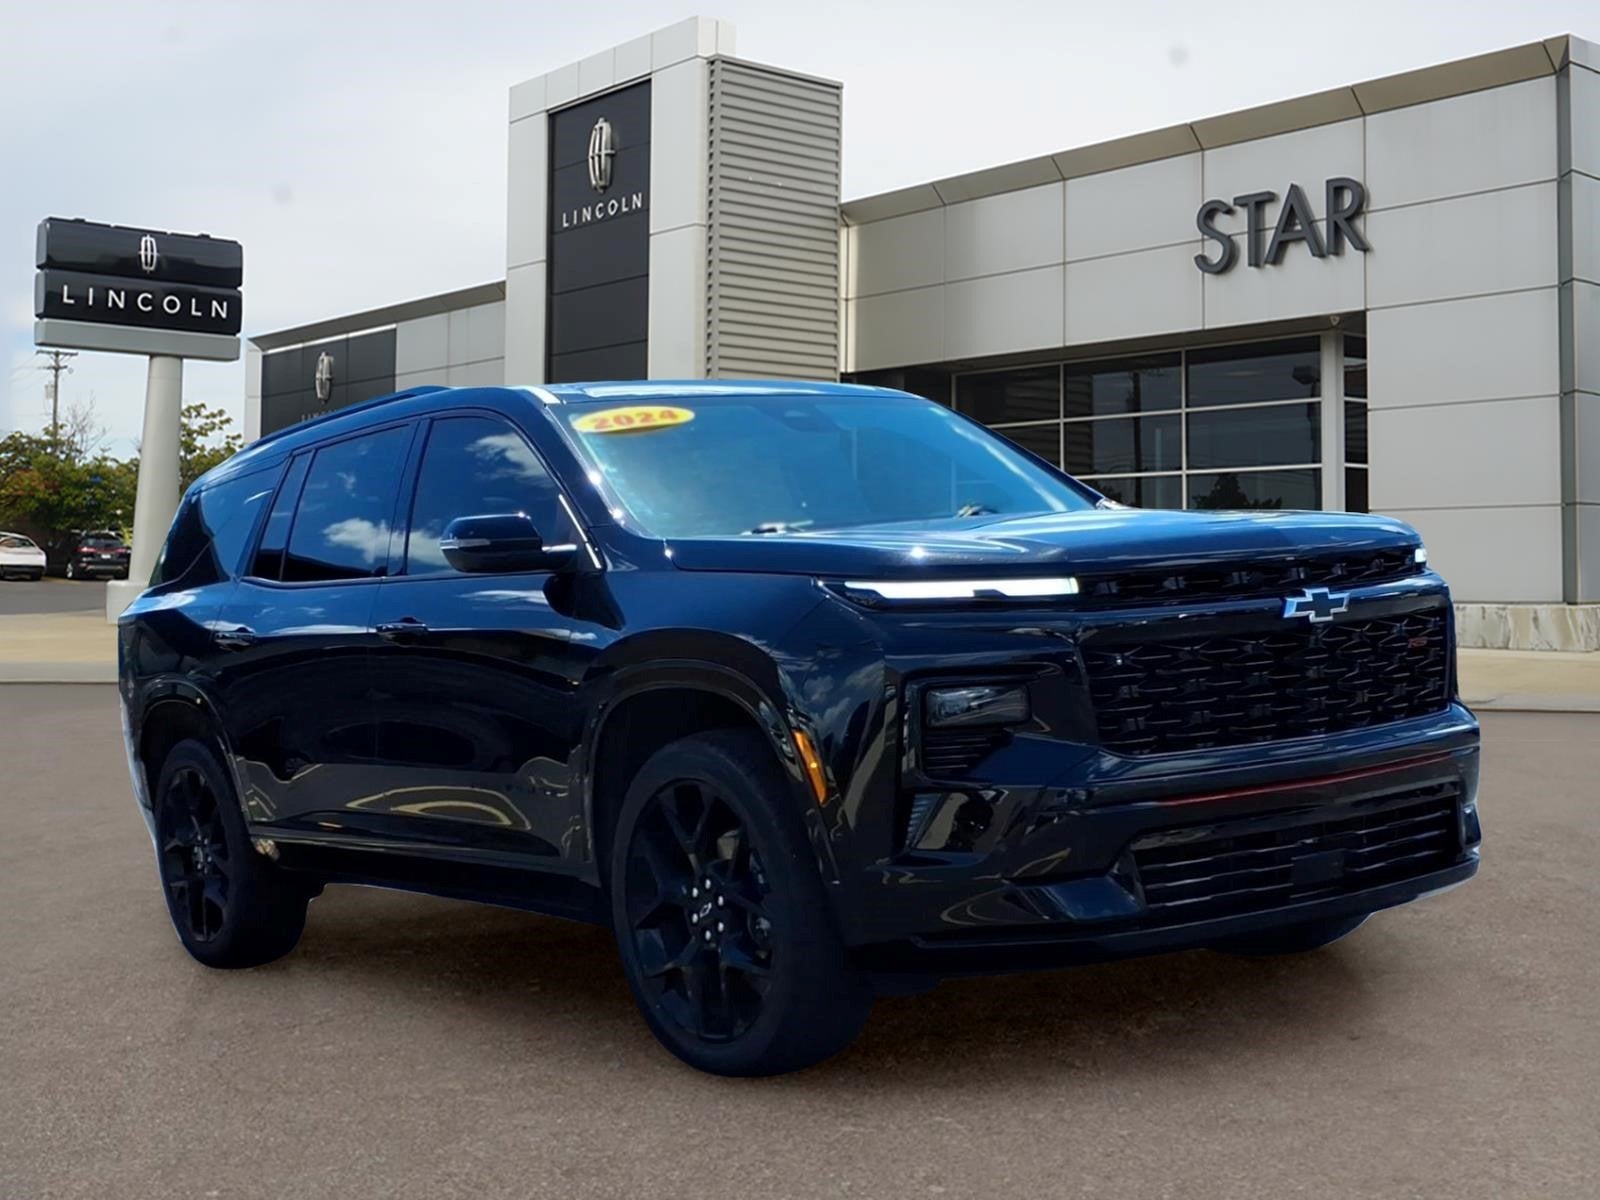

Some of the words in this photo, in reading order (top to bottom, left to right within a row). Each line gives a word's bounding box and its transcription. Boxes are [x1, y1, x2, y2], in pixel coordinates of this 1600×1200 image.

[562, 192, 642, 228] LINCOLN
[1193, 176, 1370, 275] STAR
[62, 284, 228, 319] LINCOLN
[592, 409, 679, 430] 2024
